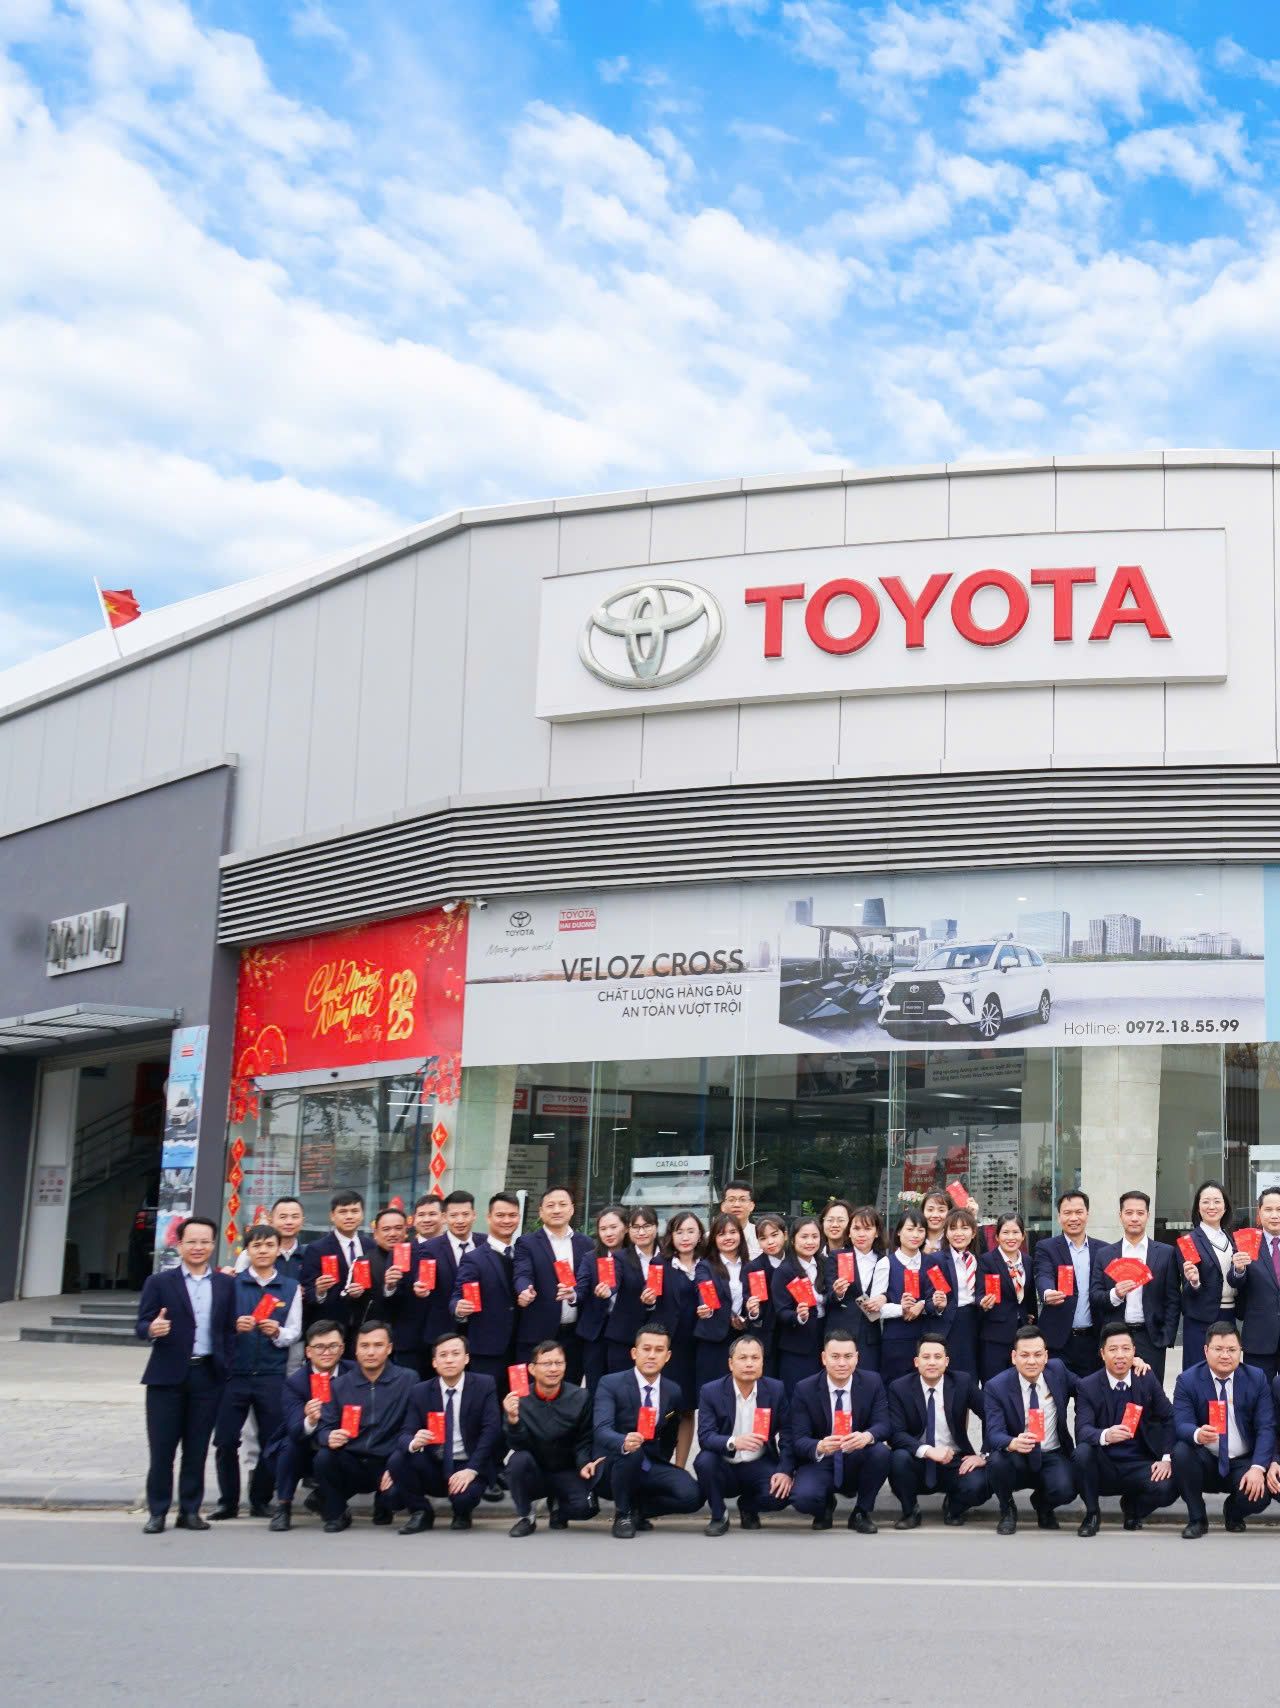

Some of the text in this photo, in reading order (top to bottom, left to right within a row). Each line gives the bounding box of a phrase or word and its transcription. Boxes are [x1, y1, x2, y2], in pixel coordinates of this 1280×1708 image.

[745, 565, 1172, 659] TOYOTA
[561, 910, 595, 919] TOYOTA
[561, 948, 745, 982] VELOZ CROSS
[598, 981, 743, 1003] CHẤT LƯỢNG HÀNG ĐẦU
[622, 999, 742, 1018] AN TOÀN VƯỢT TRỘI
[1064, 1019, 1240, 1035] Hotline: 0972.18.55.99
[557, 1095, 588, 1103] TOYOTA
[656, 1160, 689, 1168] CATALOG
